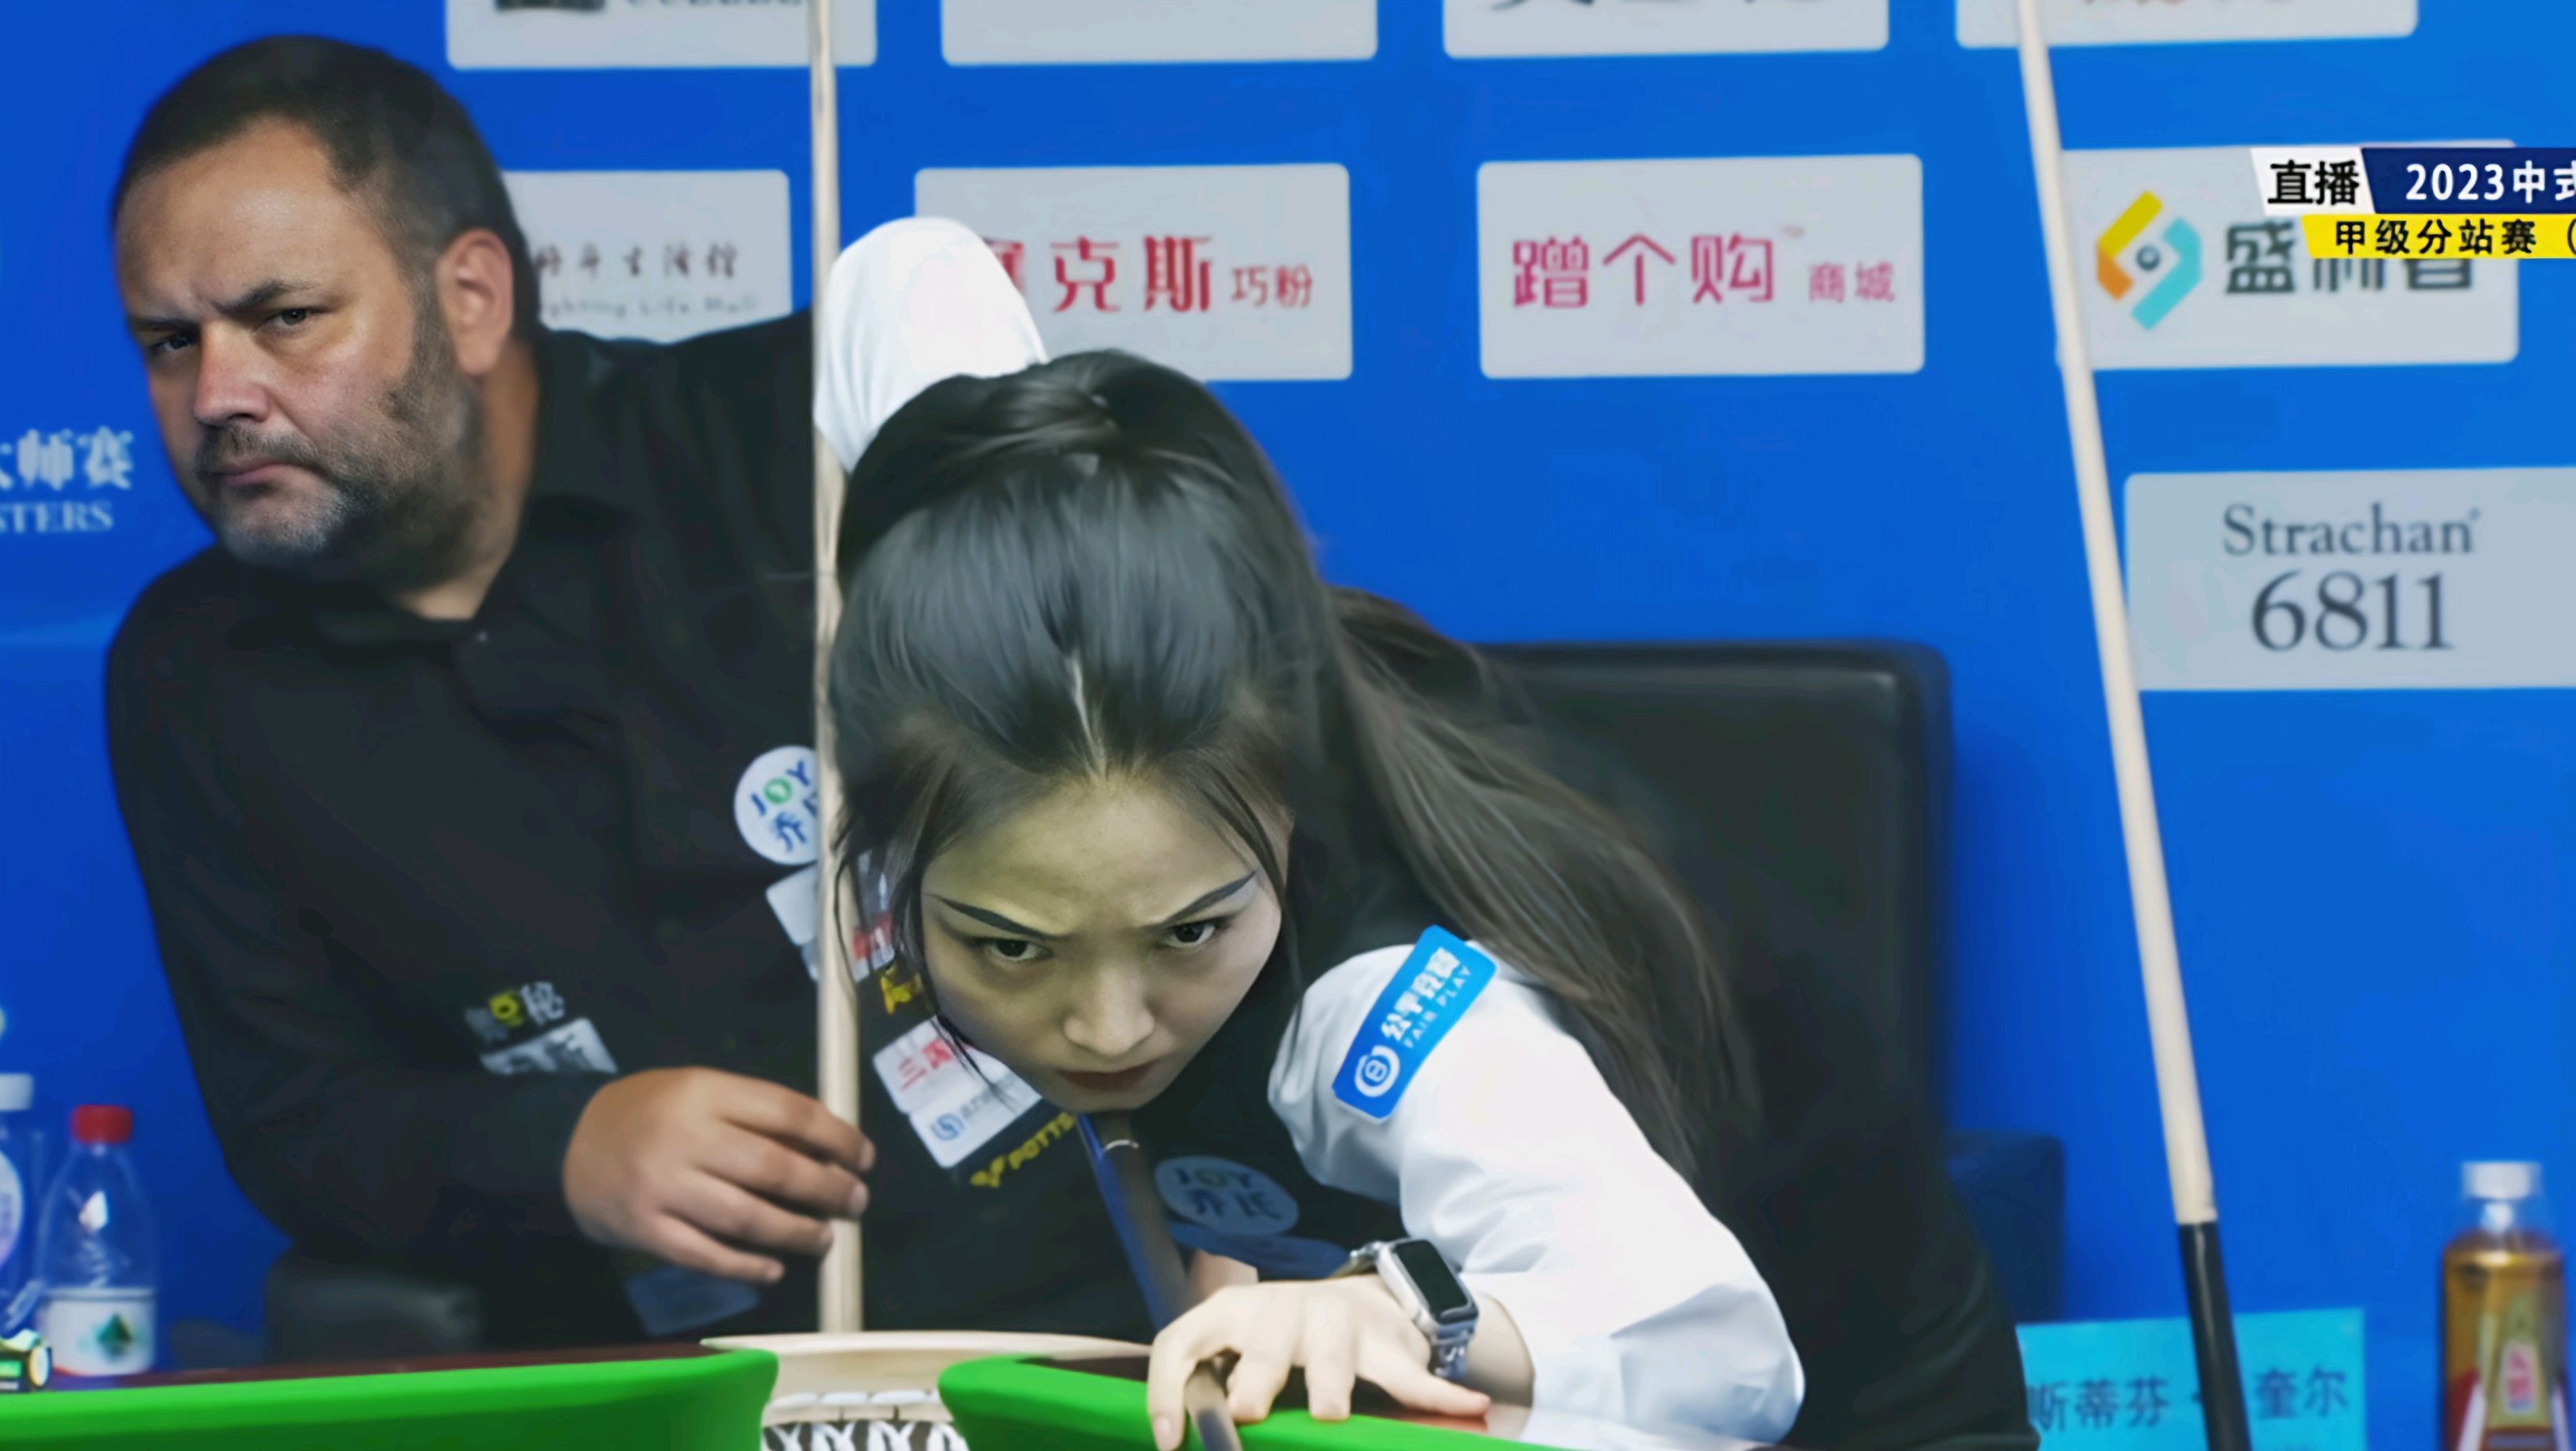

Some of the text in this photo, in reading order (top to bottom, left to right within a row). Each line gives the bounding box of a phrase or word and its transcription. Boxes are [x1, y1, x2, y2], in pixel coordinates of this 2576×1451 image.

[1231, 264, 1314, 308] 巧粉
[1513, 234, 1896, 308] 蹭个购 商城
[0, 426, 134, 489] 师赛
[2223, 501, 2474, 556] Strachan
[2250, 569, 2456, 652] 6811
